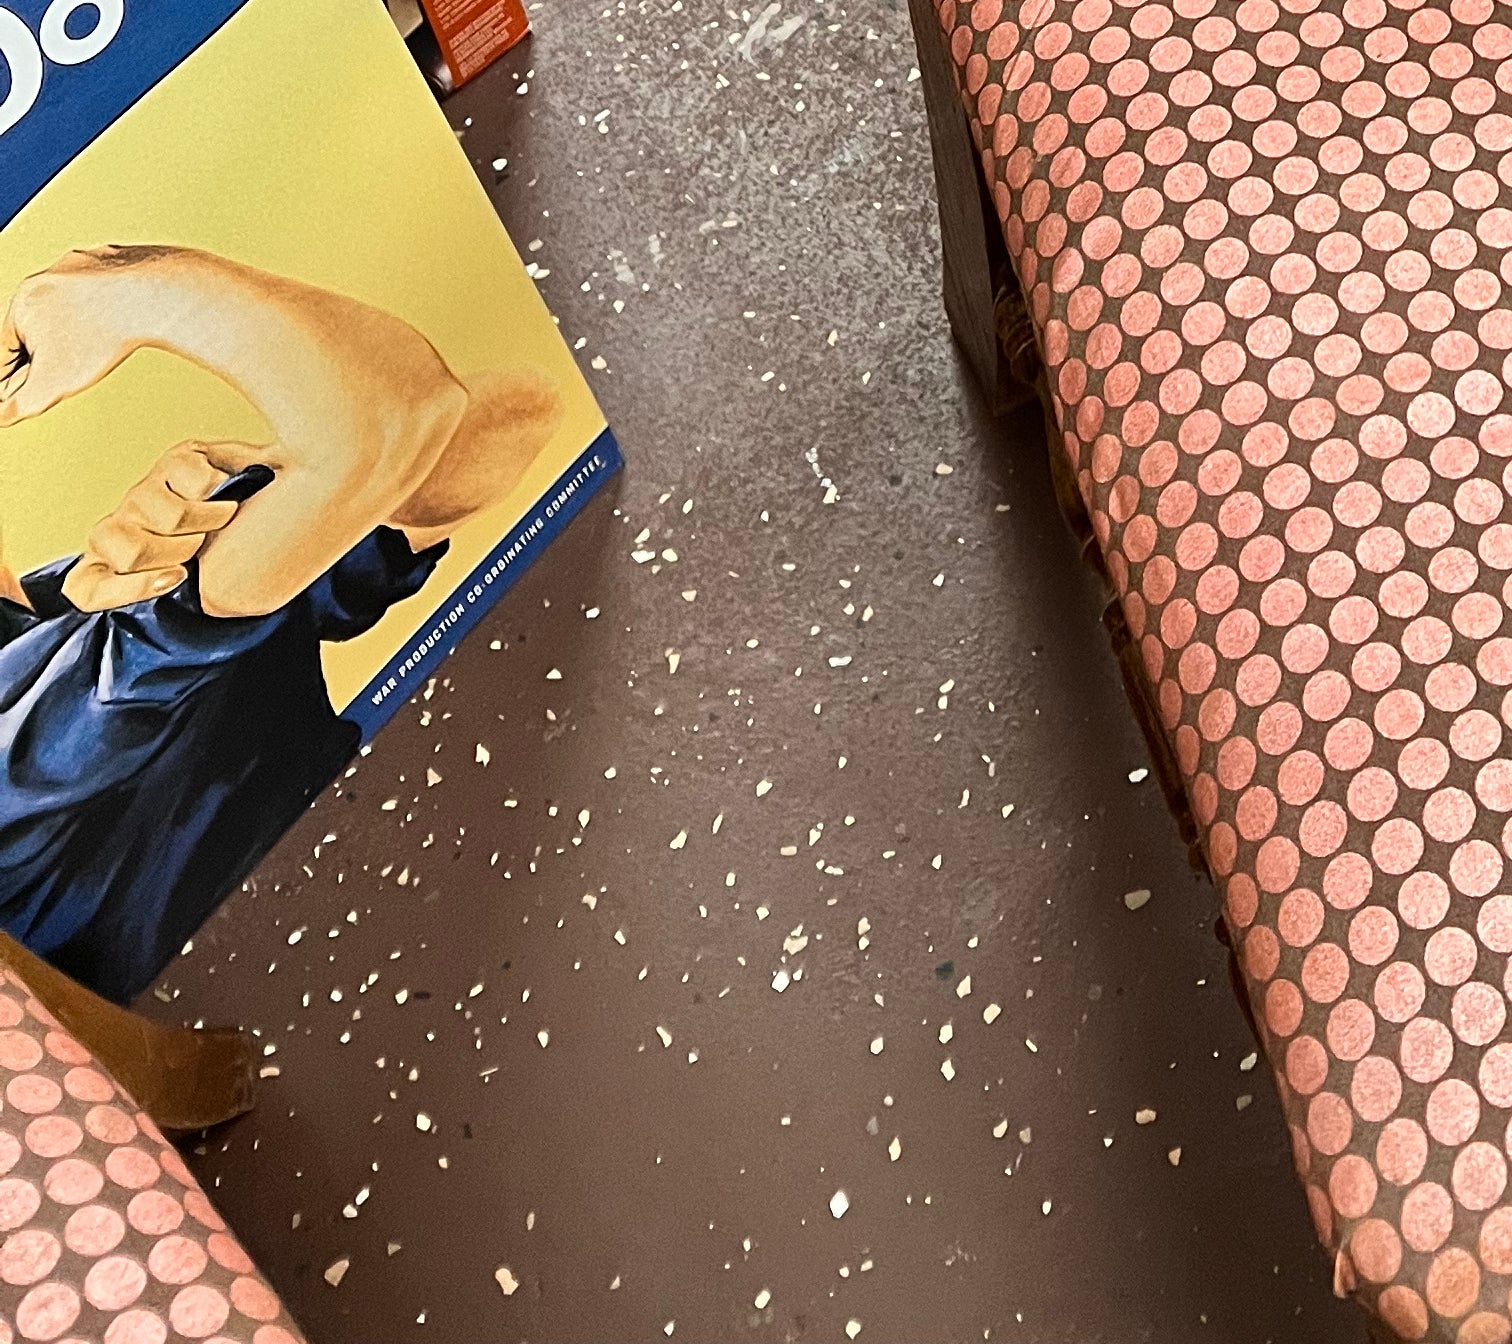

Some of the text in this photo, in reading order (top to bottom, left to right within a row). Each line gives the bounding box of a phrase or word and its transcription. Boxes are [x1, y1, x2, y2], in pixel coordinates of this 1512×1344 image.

[371, 676, 399, 706] WAR
[398, 603, 466, 679] PRODUCTION
[467, 517, 546, 605] CO-ORDINATING
